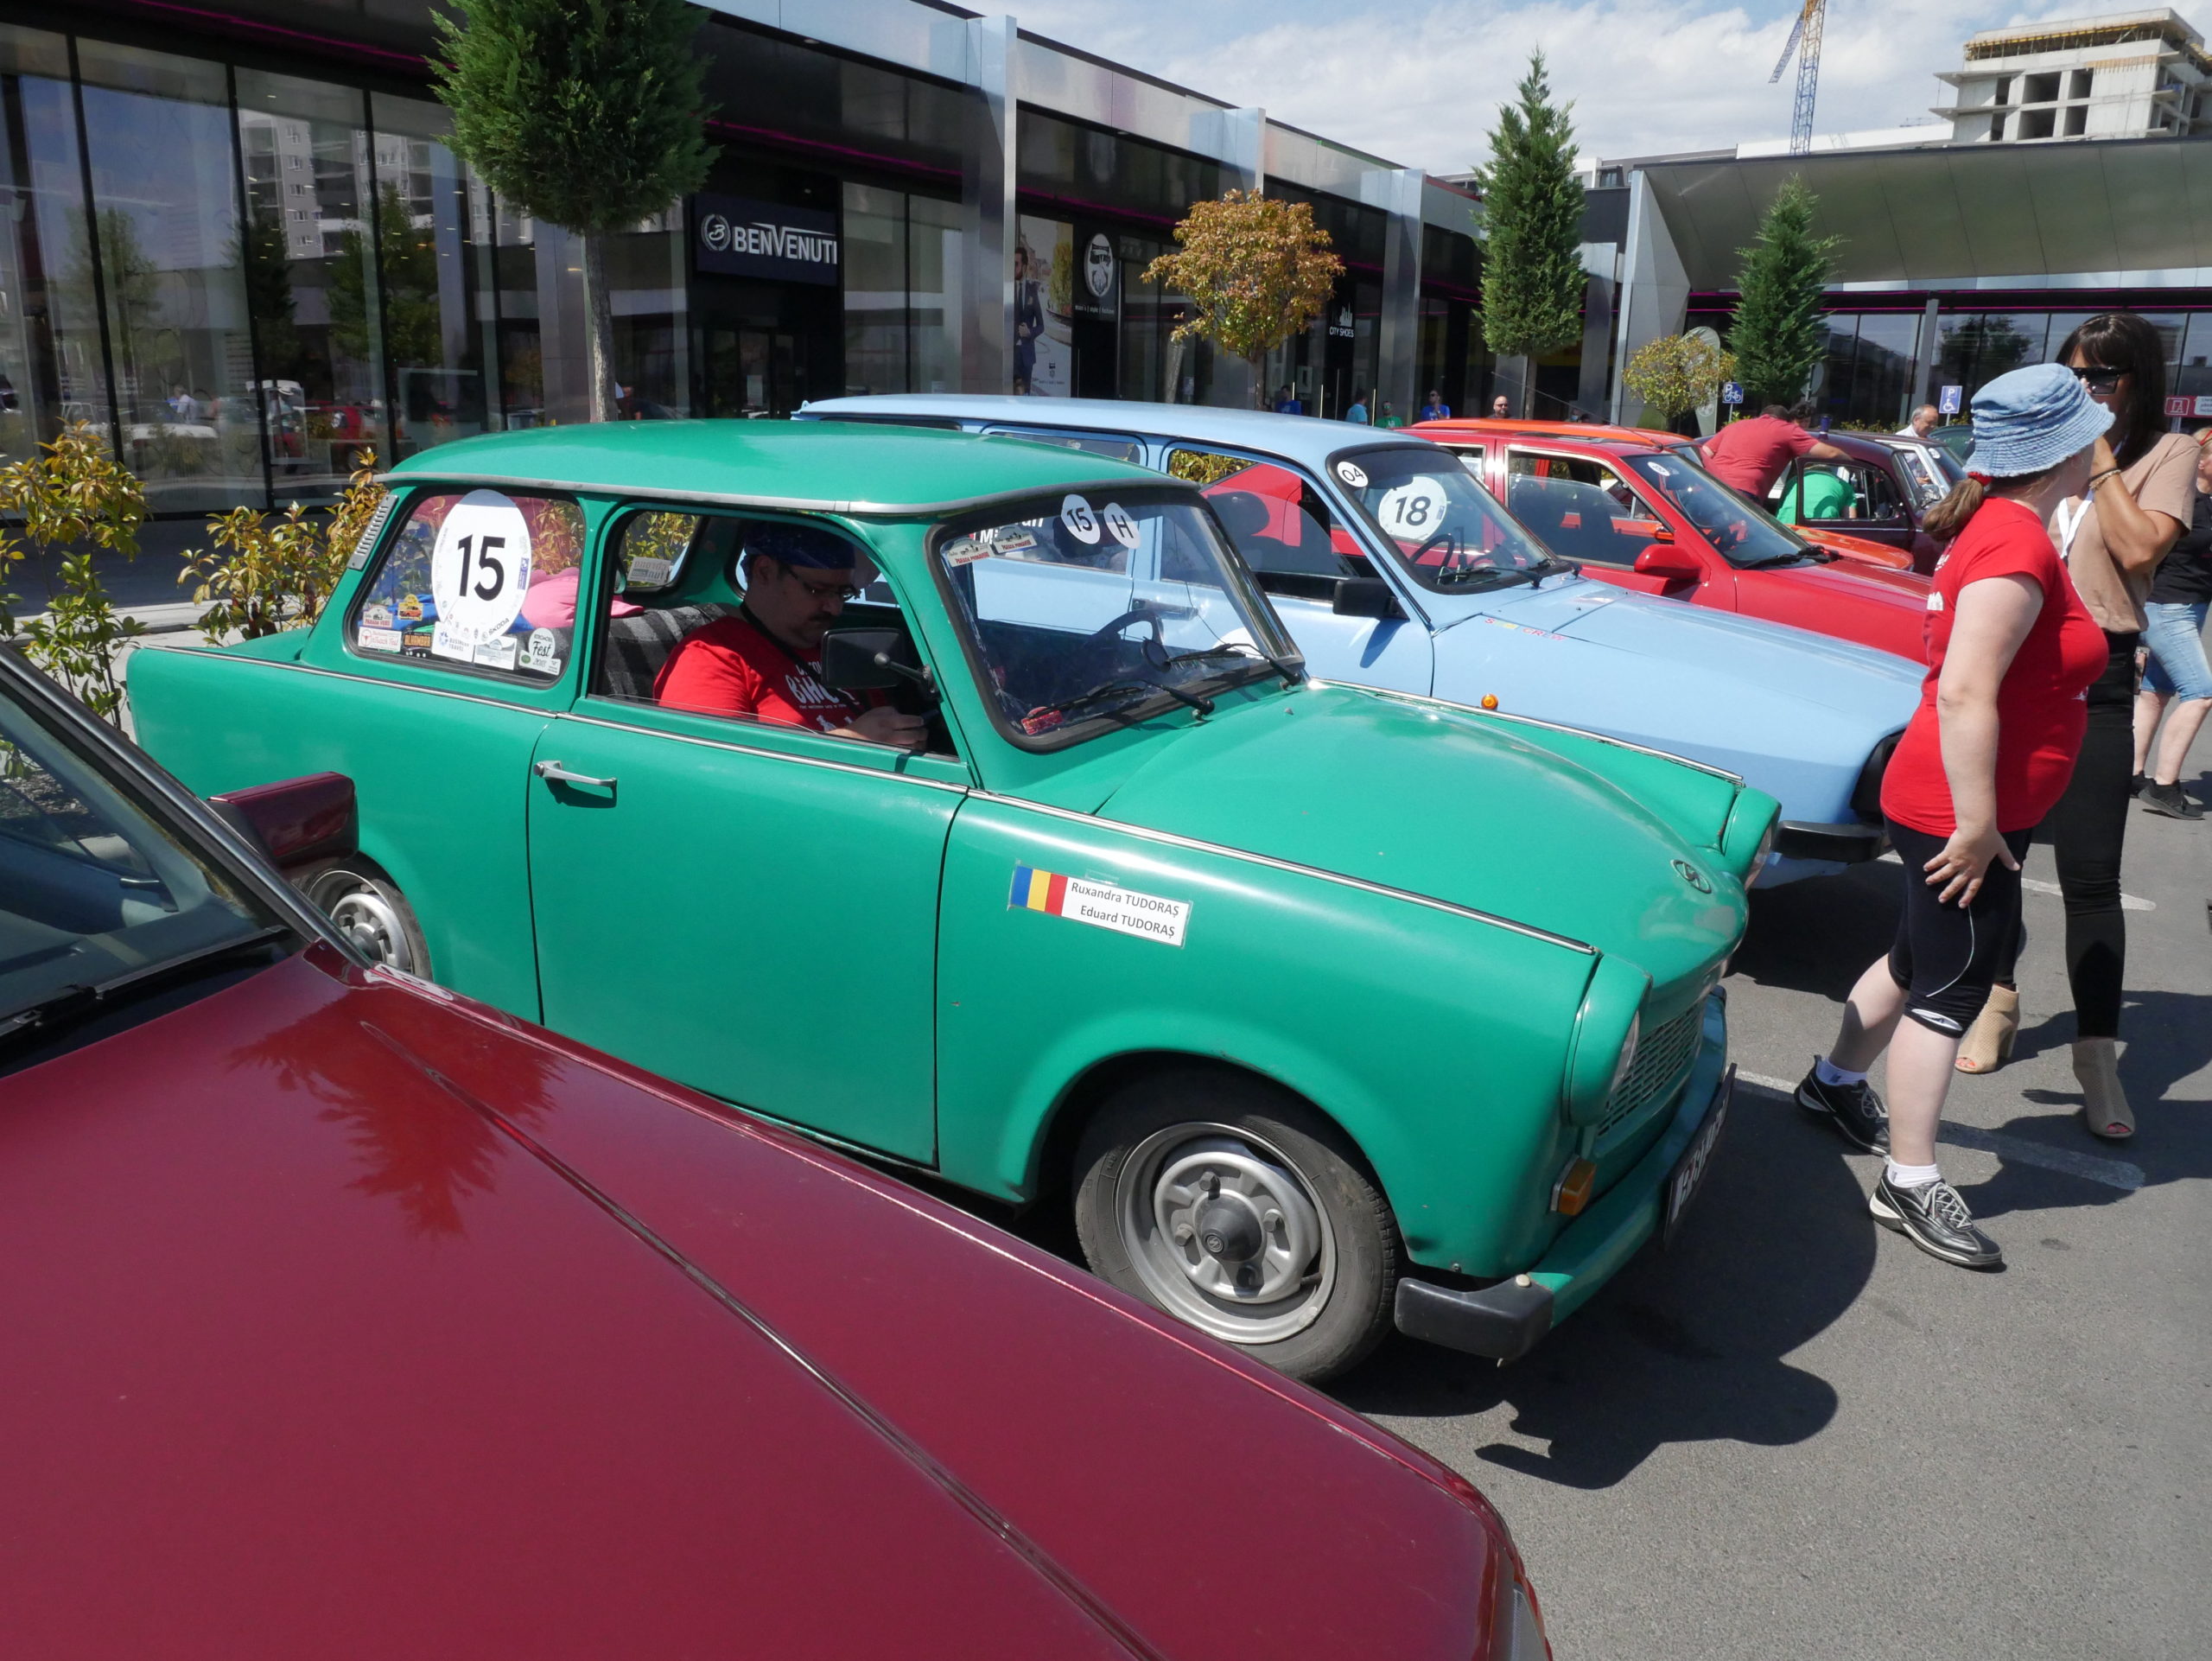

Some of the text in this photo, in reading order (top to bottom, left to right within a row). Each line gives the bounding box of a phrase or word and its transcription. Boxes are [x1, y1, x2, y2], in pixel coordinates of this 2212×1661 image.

[734, 222, 837, 264] BENVENUTI
[1330, 326, 1354, 338] CITY SHOES
[1725, 384, 1732, 393] P
[1947, 388, 1955, 397] P
[1066, 507, 1093, 532] 15
[1395, 495, 1432, 526] 18
[1111, 514, 1134, 538] H
[456, 533, 507, 602] 15
[533, 640, 551, 657] Fest
[1071, 881, 1179, 919] Ruxandra TUDORAȘ
[1080, 904, 1176, 939] Eduard TUDORAȘ
